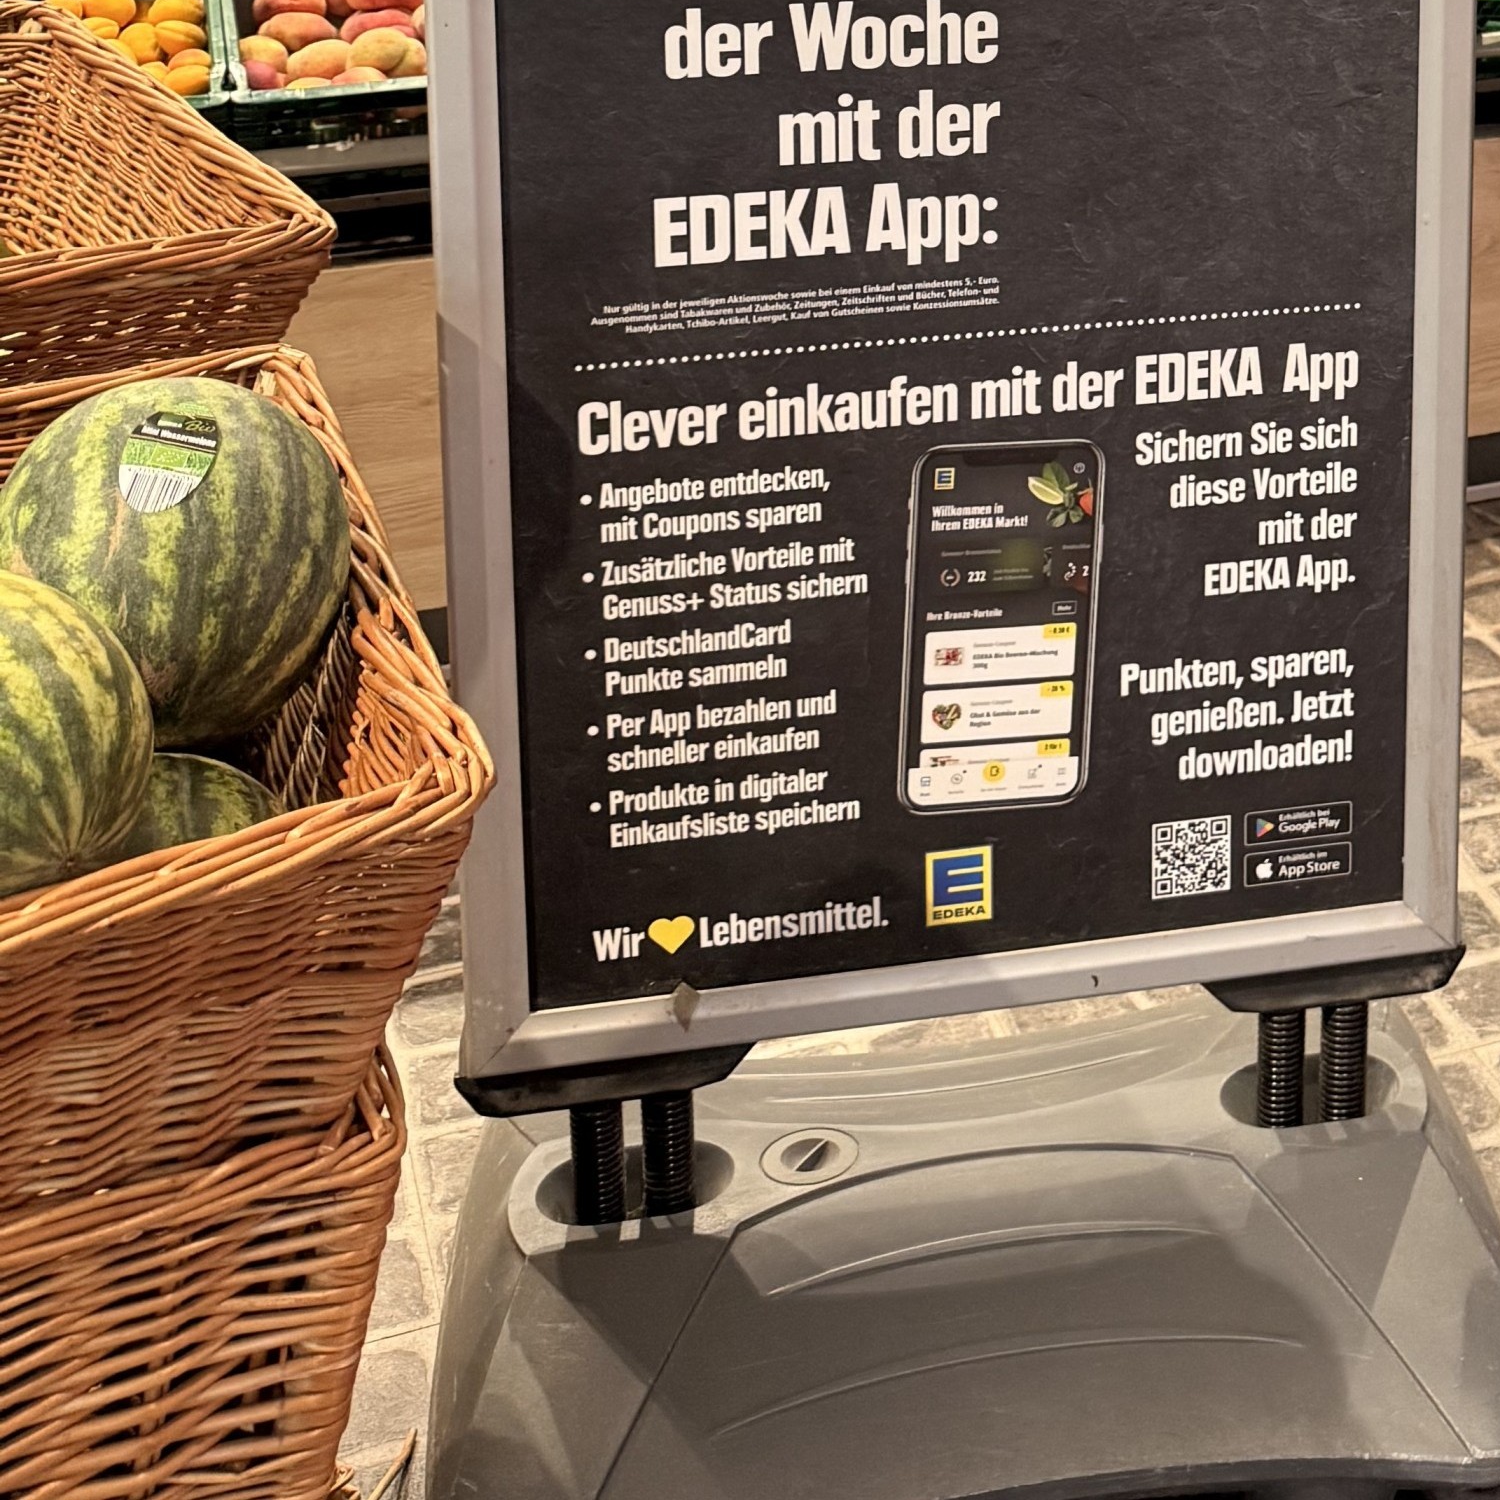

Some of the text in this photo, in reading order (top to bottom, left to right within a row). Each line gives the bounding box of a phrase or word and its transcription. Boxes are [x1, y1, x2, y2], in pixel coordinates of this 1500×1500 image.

[664, 7, 774, 80] der
[778, 88, 1001, 166] mit der
[653, 182, 999, 268] EDEKA App:
[590, 313, 658, 327] Ausgenommen
[660, 309, 679, 320] sind
[681, 306, 733, 318] Tabakwaren
[735, 303, 752, 314] und
[793, 297, 840, 311] Zeitungen,
[842, 293, 896, 306] Zeitschriften
[897, 291, 914, 301] und
[983, 285, 1000, 295] und
[603, 304, 620, 315] Nur
[622, 301, 650, 315] gültig
[651, 300, 661, 311] in
[662, 298, 677, 310] der
[678, 296, 726, 310] jeweiligen
[727, 291, 789, 304] Aktionswoche
[791, 289, 817, 300] sowie
[818, 287, 833, 298] bei
[834, 287, 861, 296] einem
[863, 282, 895, 294] Einkauf
[897, 283, 913, 291] von
[915, 278, 963, 290] mindestens
[625, 320, 685, 335] Handykarten,
[790, 308, 811, 320] Kauf
[813, 310, 829, 318] von
[831, 305, 884, 317] Gutscheinen
[886, 303, 911, 312] sowie
[577, 342, 1359, 456] Clever einkaufen mit der EDEKA App
[1135, 415, 1358, 466] Sichern Sie sich
[599, 465, 831, 512] Angebote entdecken,
[1169, 460, 1358, 509] diese Vorteile
[600, 501, 822, 544] mit Coupons sparen
[931, 515, 1028, 532] Ihrem EDEKA Markt!
[932, 503, 1004, 518] Willkommen in
[1258, 507, 1358, 546] mit der
[600, 536, 856, 587] Zusätzliche Vorteile mit
[967, 570, 987, 583] 232
[1204, 553, 1356, 597] EDEKA App.
[602, 572, 868, 621] Genuss+ Status sichern
[604, 618, 792, 664] DeutschlandCard
[605, 653, 788, 697] Punkte sammeln
[1120, 648, 1355, 697] Punkten, sparen,
[606, 688, 837, 740] Per App bezahlen und
[1151, 687, 1355, 746] genießen. Jetzt
[607, 726, 820, 773] schneller einkaufen
[1178, 729, 1353, 781] downloaden!
[609, 768, 829, 816] Produkte in digitaler
[610, 799, 861, 848] Einkaufsliste speichern
[1278, 817, 1341, 834] Google Play
[1278, 860, 1341, 879] App Store
[592, 896, 889, 962] Wir Lebensmittel.
[932, 905, 987, 921] EDEKA
